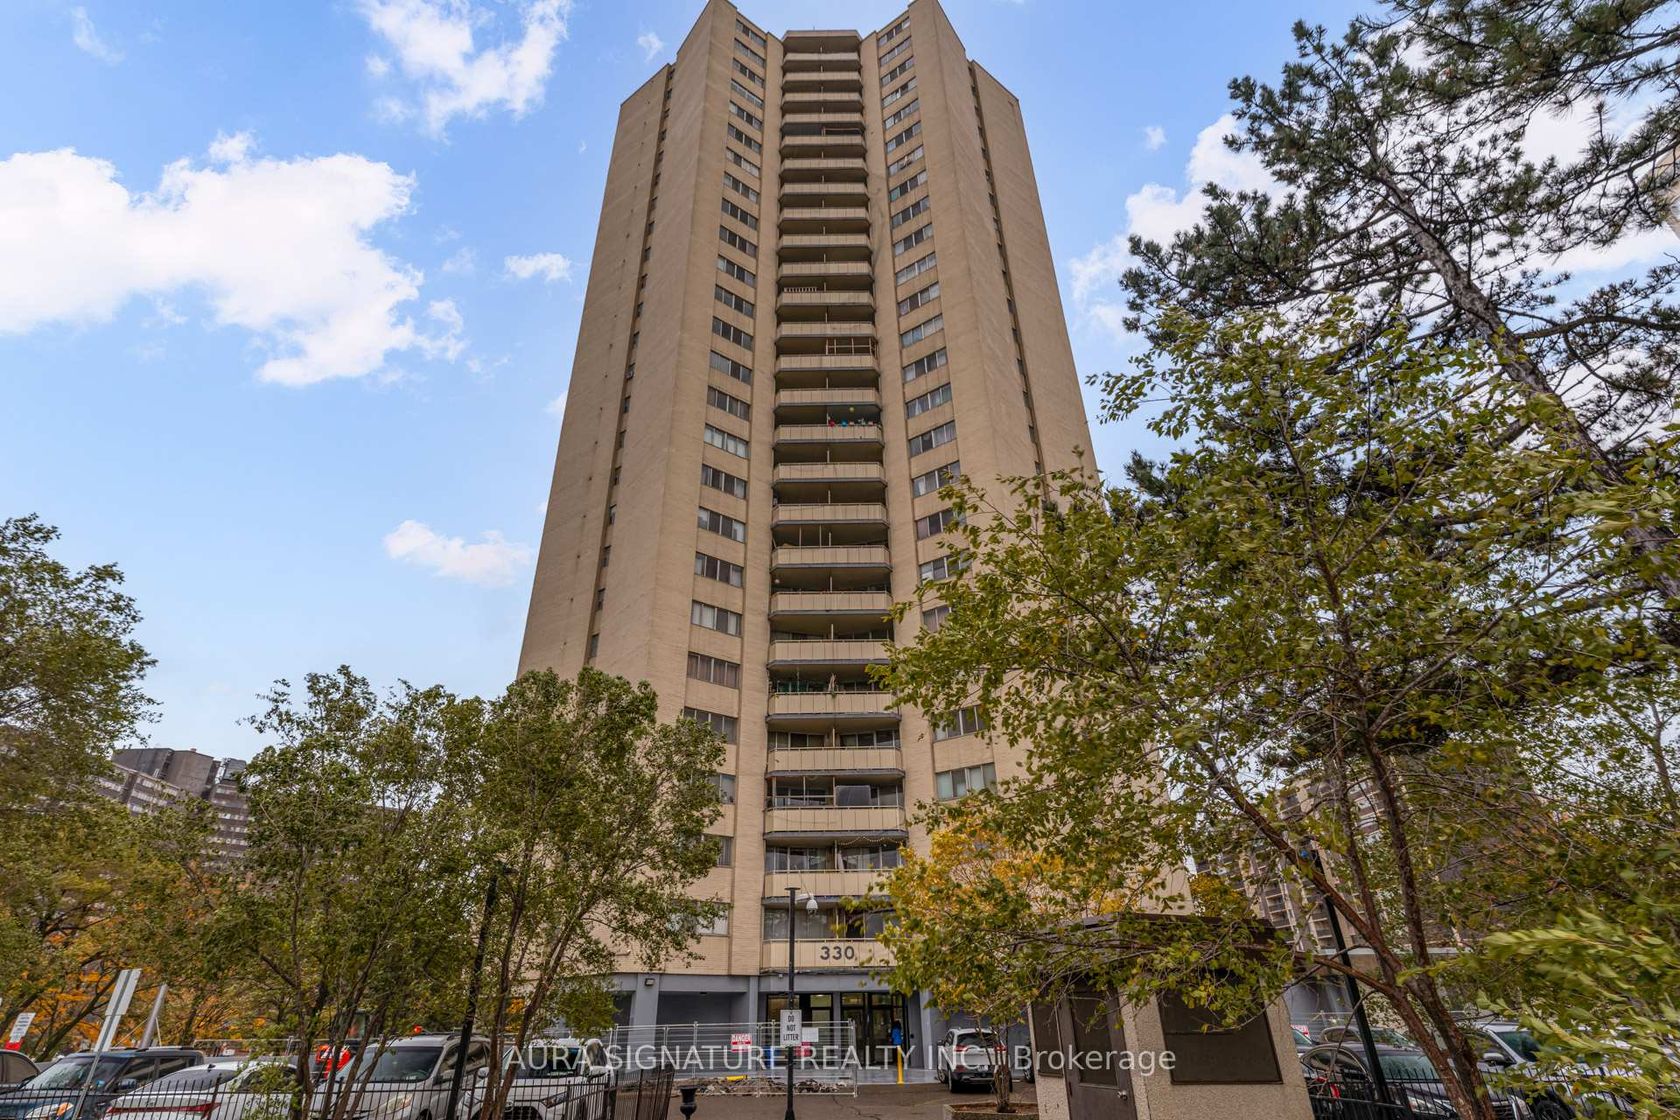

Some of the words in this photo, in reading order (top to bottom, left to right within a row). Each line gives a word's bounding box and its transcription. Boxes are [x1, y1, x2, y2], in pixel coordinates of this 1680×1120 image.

[820, 946, 855, 960] 330
[787, 1015, 795, 1023] DO
[786, 1024, 796, 1032] NOT
[783, 1033, 799, 1041] LITTER
